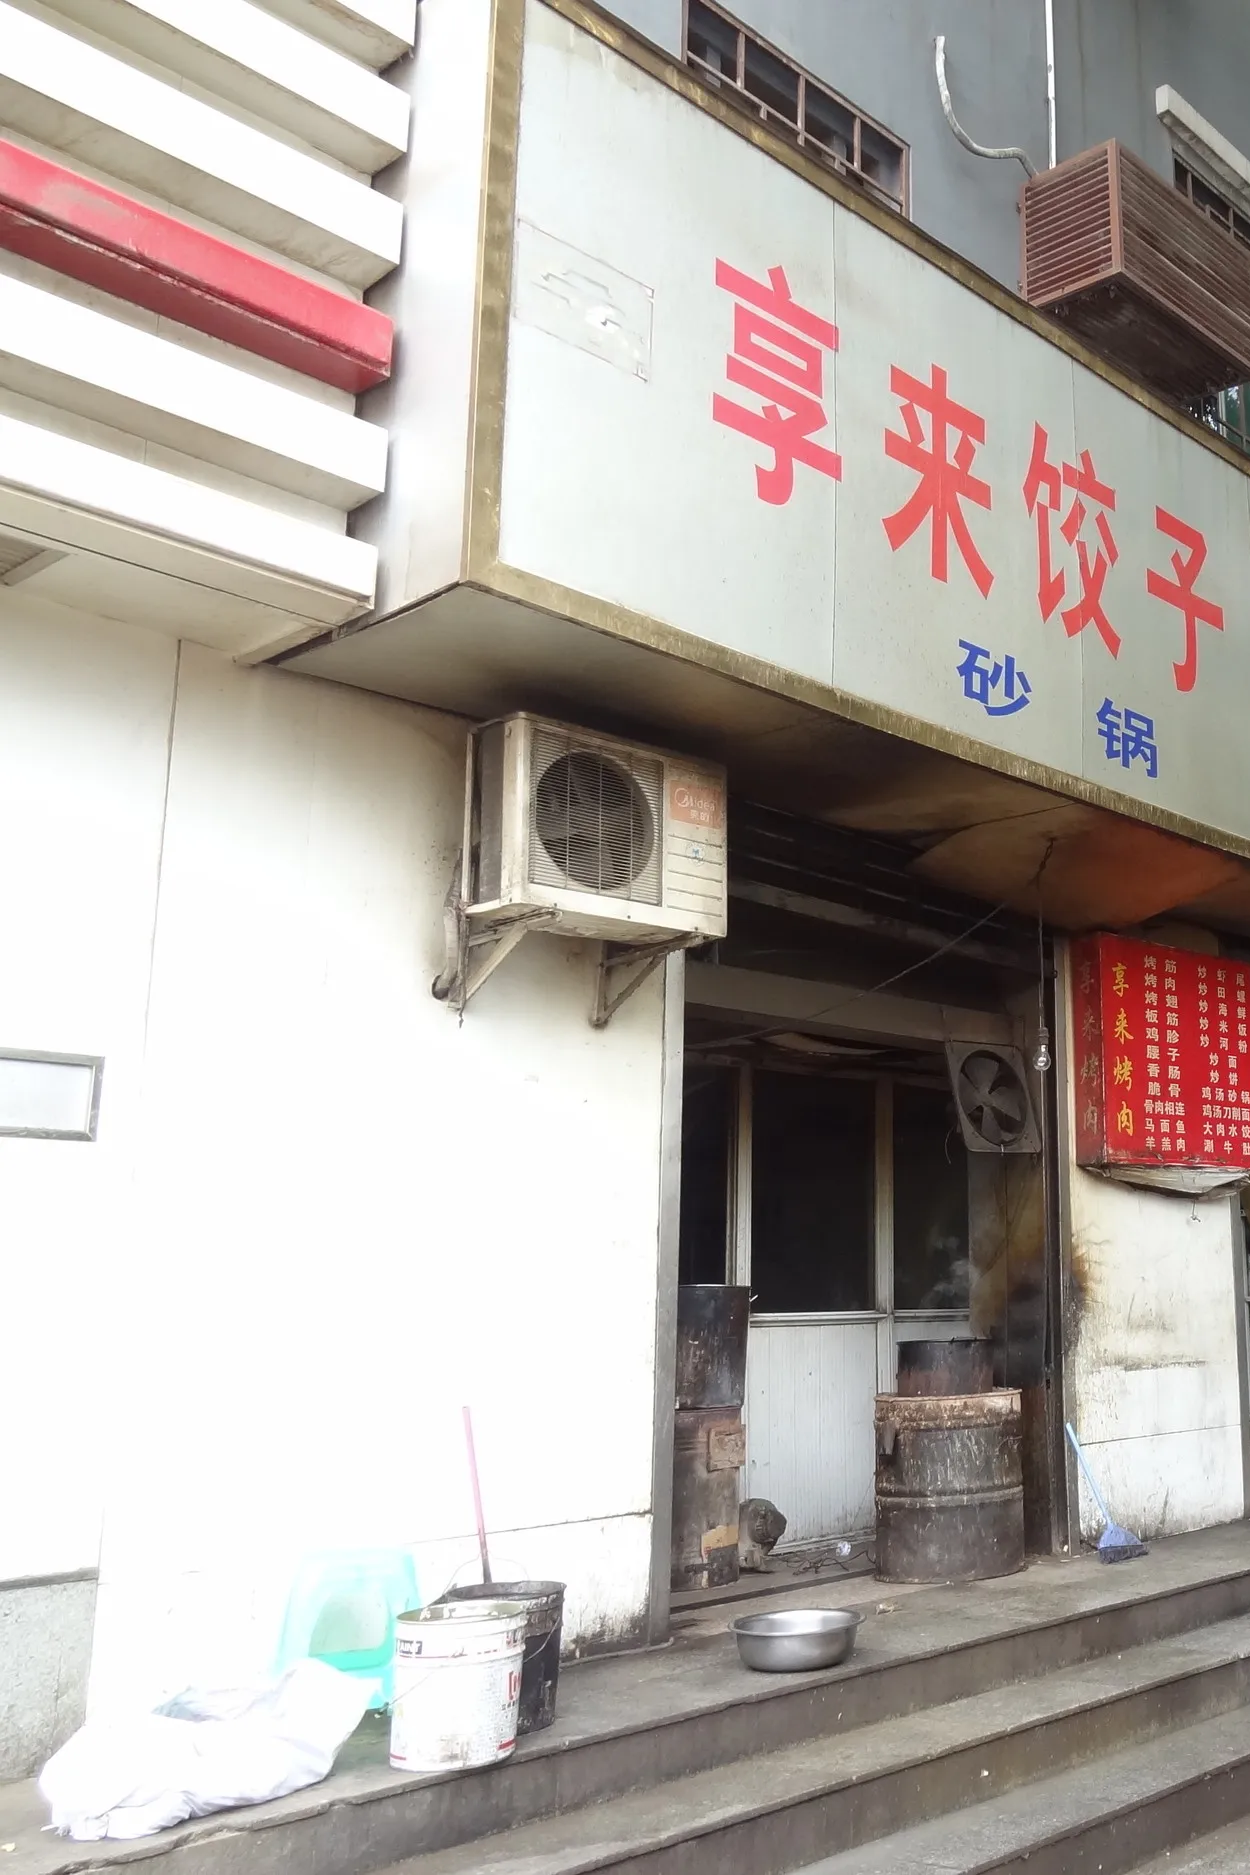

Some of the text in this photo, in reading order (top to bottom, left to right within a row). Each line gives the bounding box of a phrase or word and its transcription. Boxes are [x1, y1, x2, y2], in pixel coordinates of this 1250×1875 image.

[711, 257, 1224, 692] 享来饺子
[957, 639, 1160, 779] 砂锅
[1144, 955, 1177, 973] 烤筋
[1144, 973, 1176, 991] 烤肉
[1197, 965, 1245, 987] 炒虾尾
[1145, 991, 1178, 1008] 烤翅
[1198, 982, 1246, 1003] 炒田螺
[1145, 1009, 1179, 1026] 板筋
[1199, 1000, 1246, 1020] 炒海鲜
[1199, 1017, 1247, 1036] 炒米饭
[1111, 962, 1134, 1137] 享来烤肉
[1200, 1034, 1248, 1054] 炒河粉
[1146, 1045, 1180, 1061] 腰子
[1209, 1052, 1237, 1069] 炒面
[1147, 1063, 1181, 1079] 香肠
[1210, 1070, 1238, 1086] 炒饼
[1148, 1082, 1181, 1098] 脆骨
[1201, 1086, 1250, 1104] 鸡汤砂锅
[1144, 1099, 1185, 1116] 骨肉相连
[1202, 1104, 1250, 1121] 鸡汤刀削面
[1145, 1118, 1186, 1134] 马面鱼
[1203, 1121, 1250, 1138] 大肉水饺
[1145, 1136, 1186, 1152] 羊羔肉
